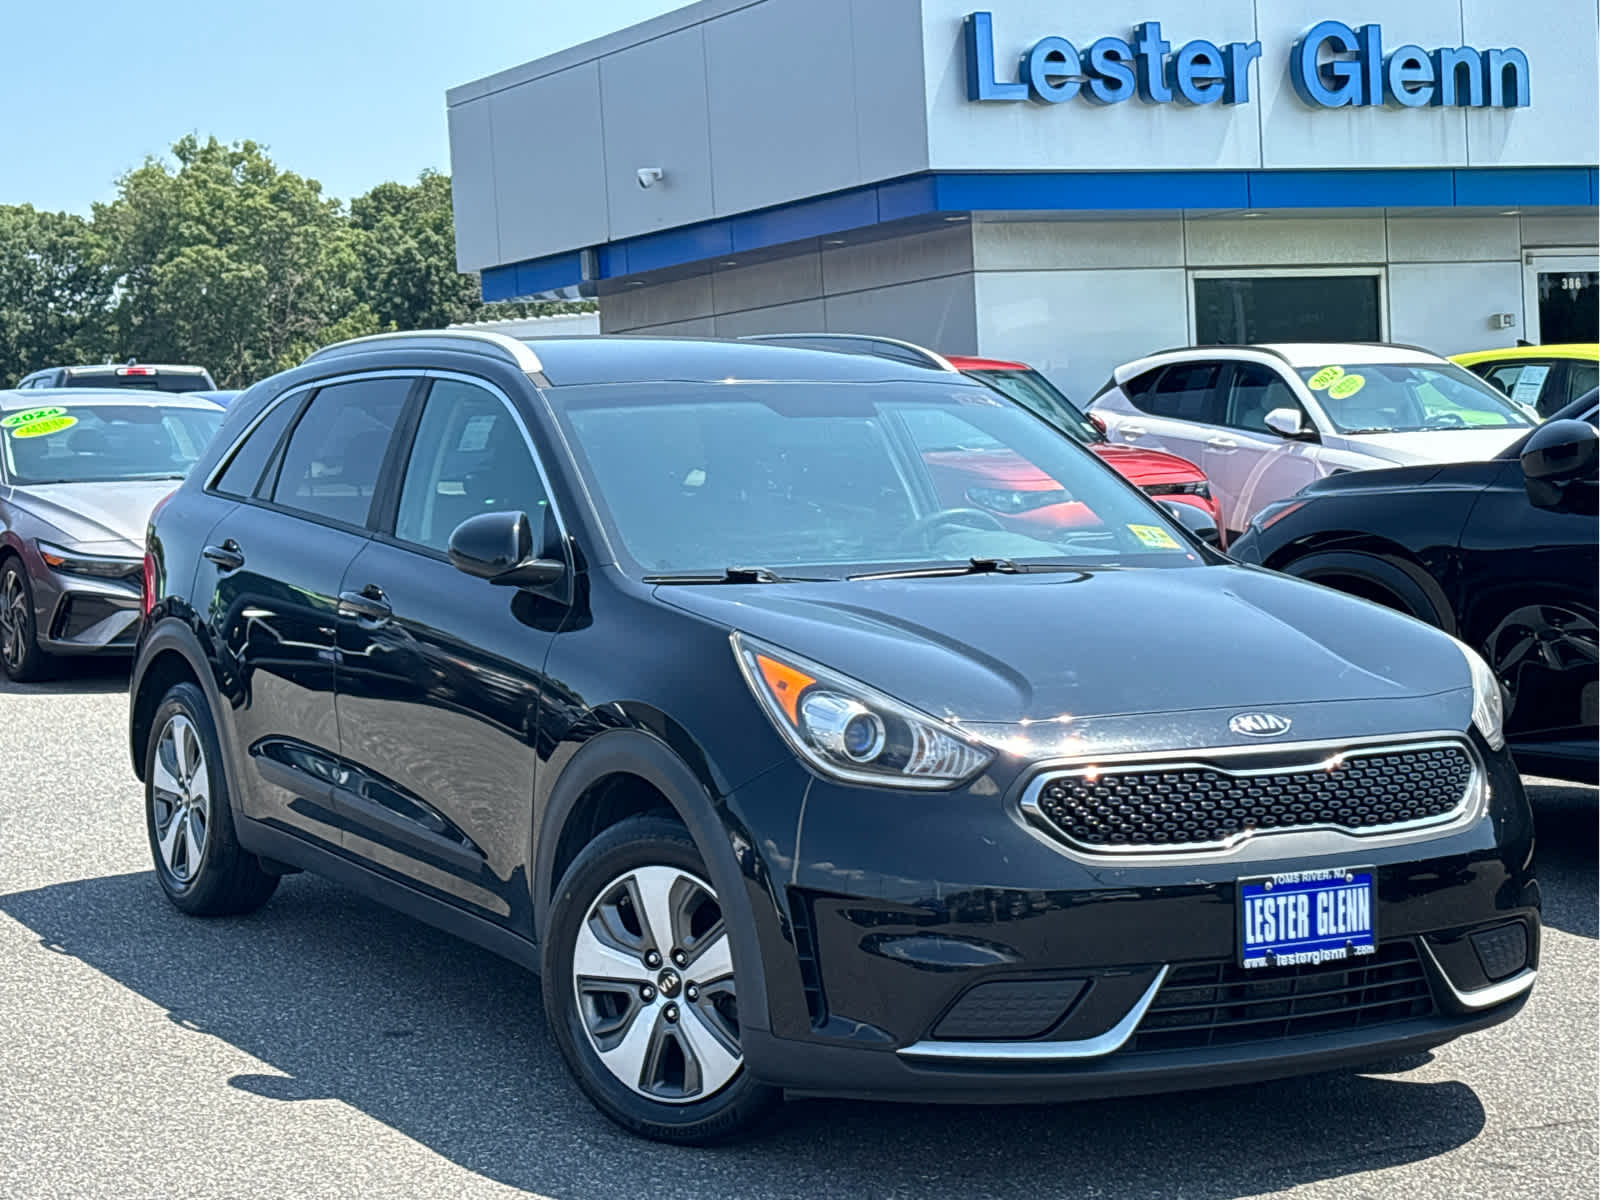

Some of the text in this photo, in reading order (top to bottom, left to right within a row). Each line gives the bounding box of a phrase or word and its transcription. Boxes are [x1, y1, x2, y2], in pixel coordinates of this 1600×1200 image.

[961, 11, 1531, 108] Lester Glenn
[9, 408, 59, 425] 2024
[1236, 713, 1286, 732] KIA
[1272, 873, 1300, 885] TOMS
[1245, 886, 1371, 945] LESTER GLENN
